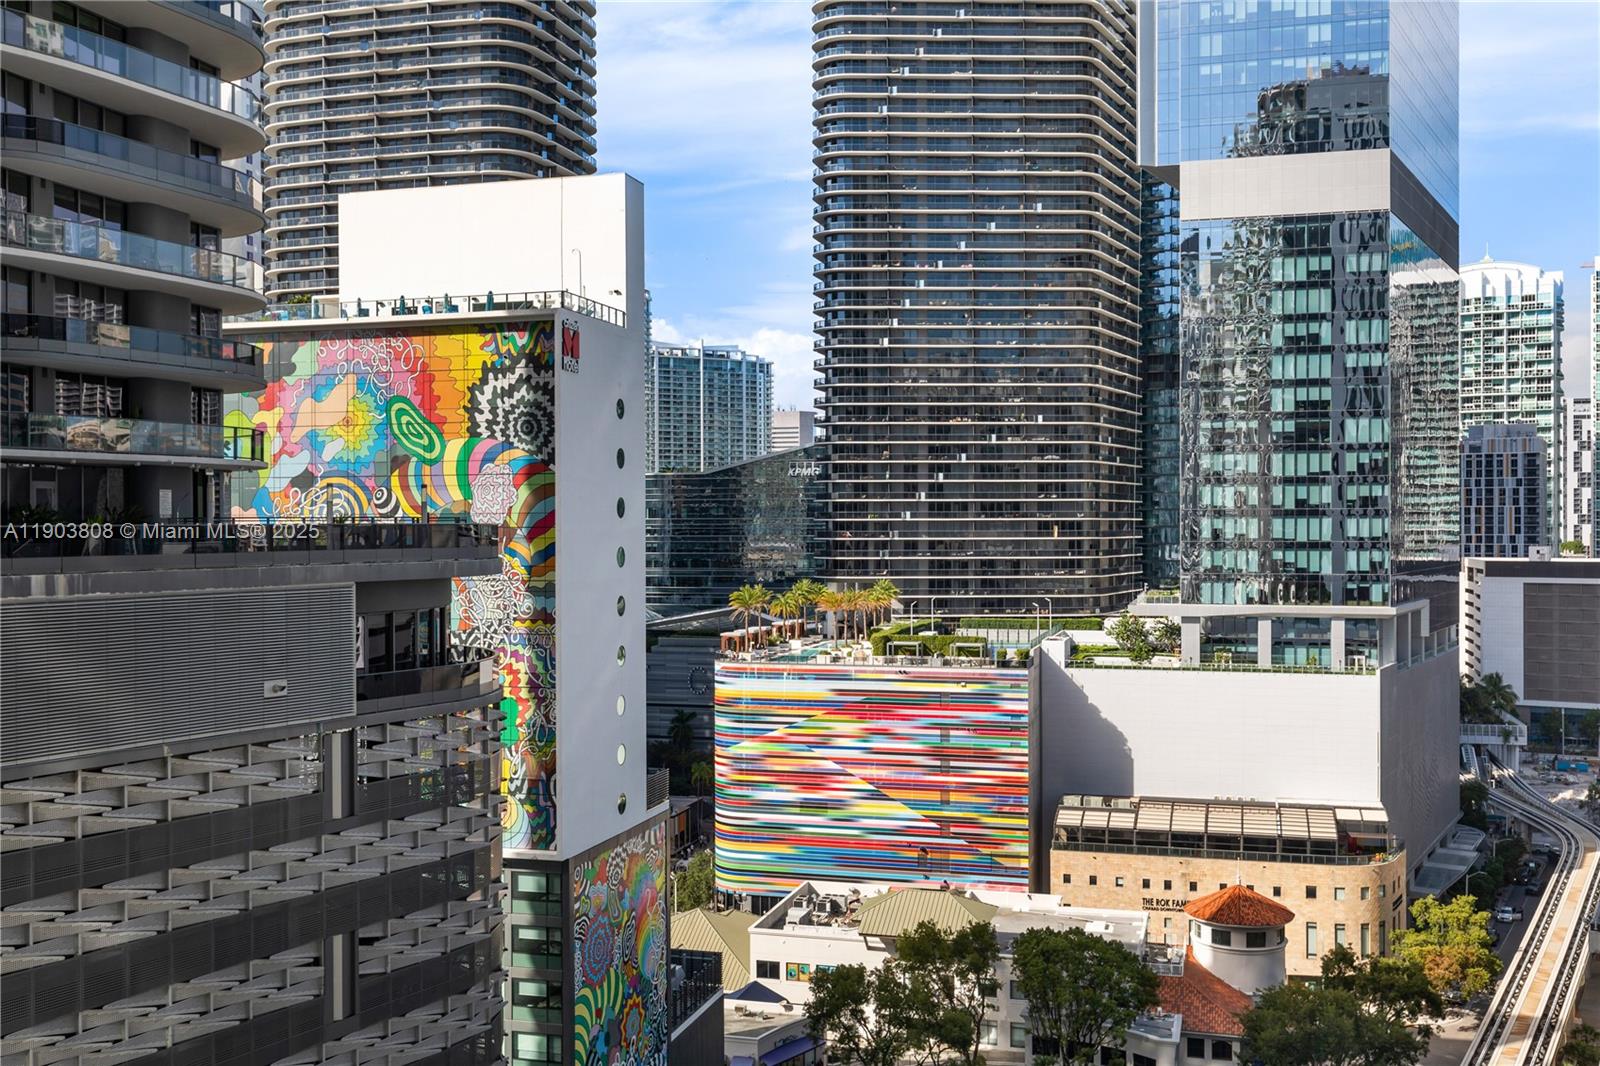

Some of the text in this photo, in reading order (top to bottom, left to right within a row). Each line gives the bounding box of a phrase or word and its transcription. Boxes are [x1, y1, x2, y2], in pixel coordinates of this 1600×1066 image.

[787, 467, 820, 476] KPMG
[1142, 898, 1191, 908] THE ROK FAM
